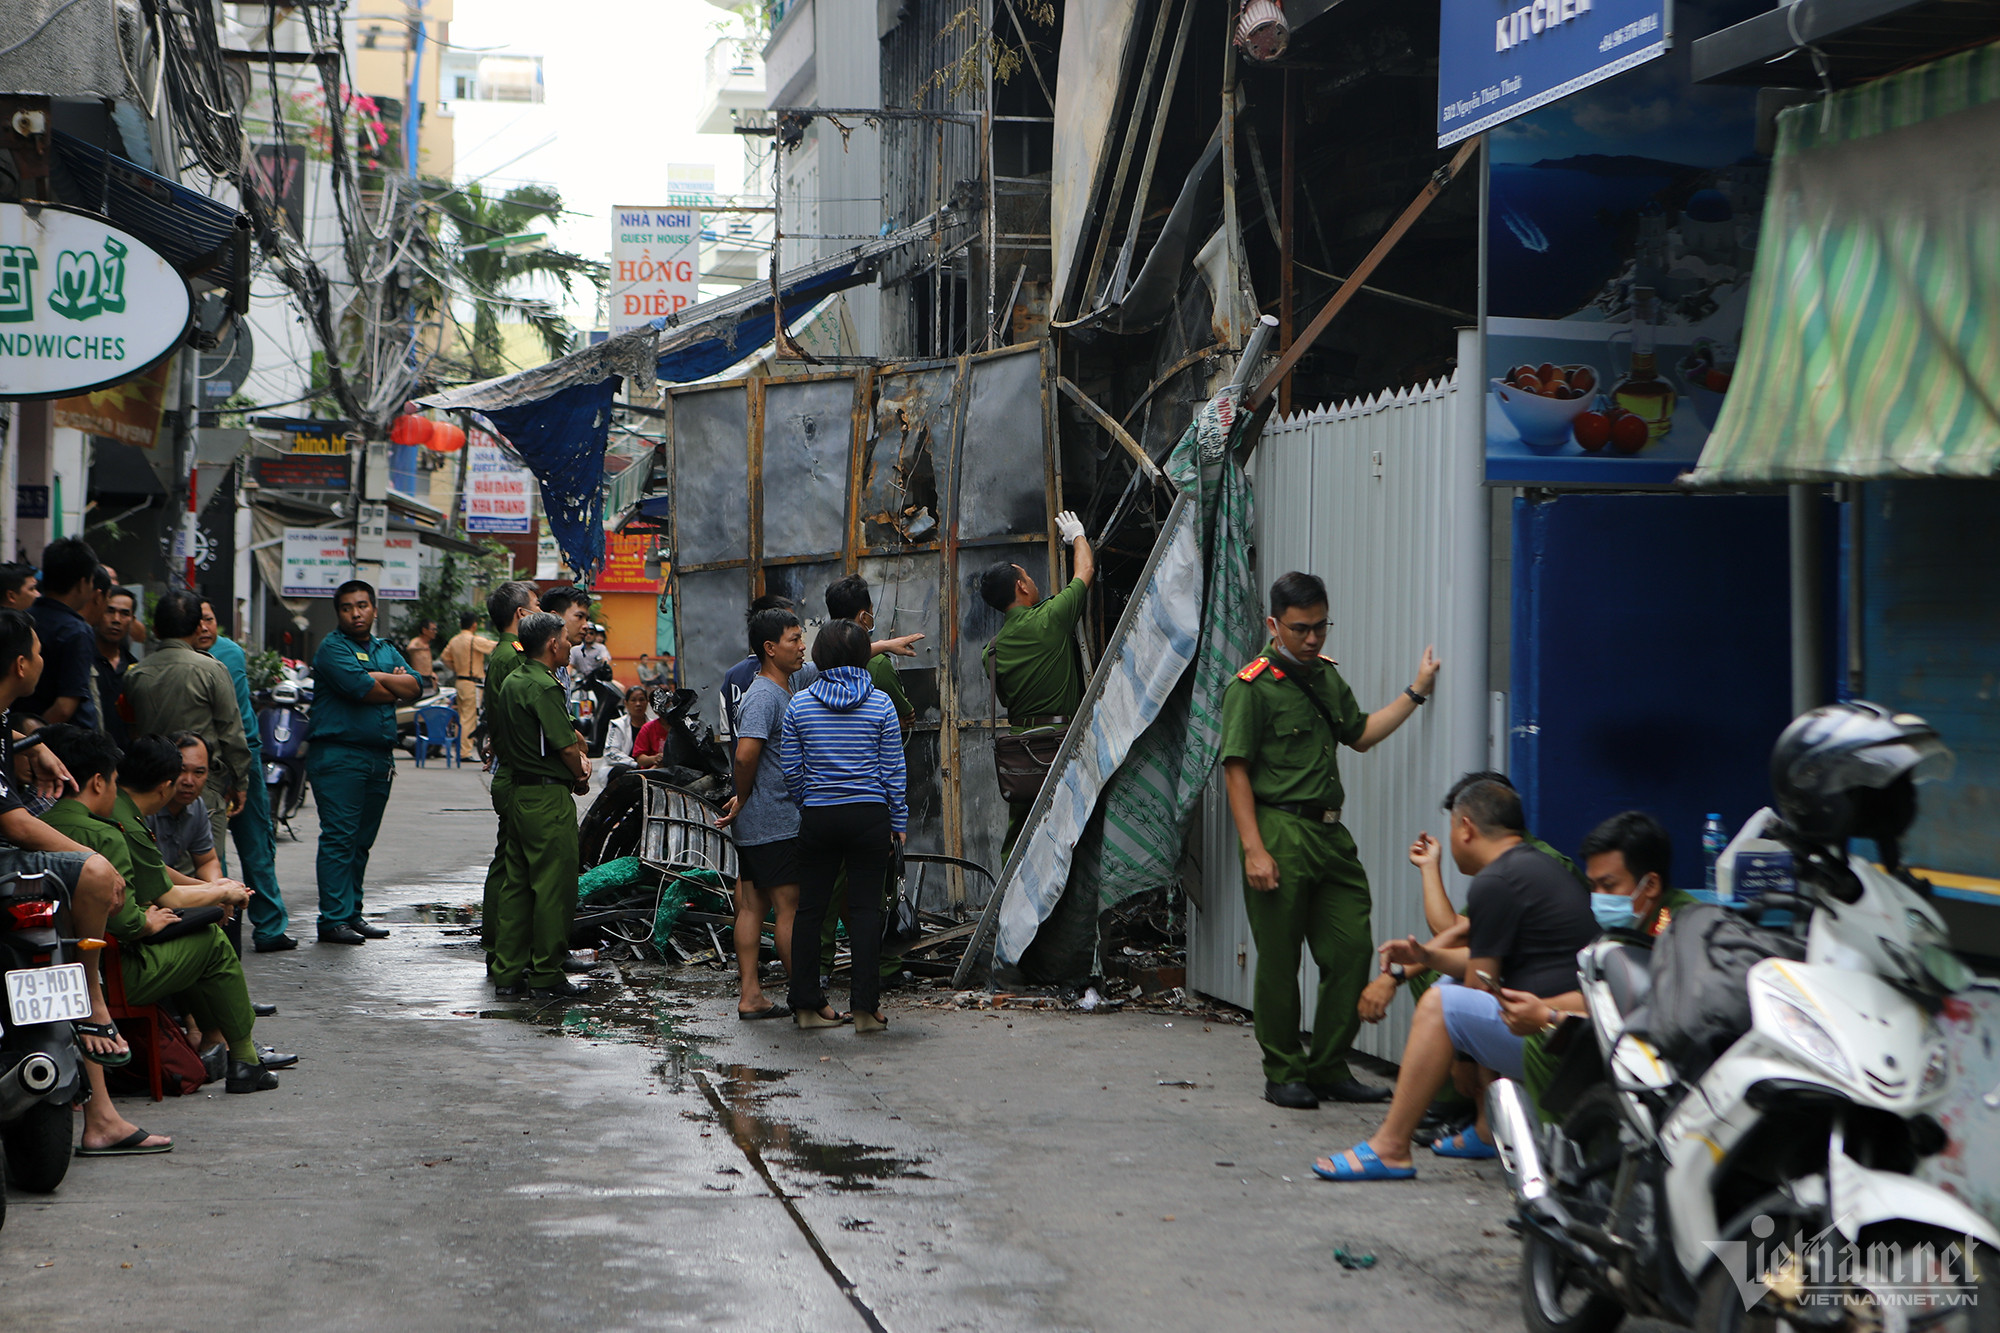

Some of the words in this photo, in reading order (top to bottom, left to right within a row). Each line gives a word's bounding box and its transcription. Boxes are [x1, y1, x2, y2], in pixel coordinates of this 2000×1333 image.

[620, 210, 651, 227] NHÀ
[621, 233, 654, 244] GUEST
[657, 234, 691, 244] HOUSE
[617, 248, 693, 282] HỒNG
[1217, 397, 1233, 427] MINH
[493, 499, 526, 514] TRANG
[15, 993, 86, 1022] 087.15
